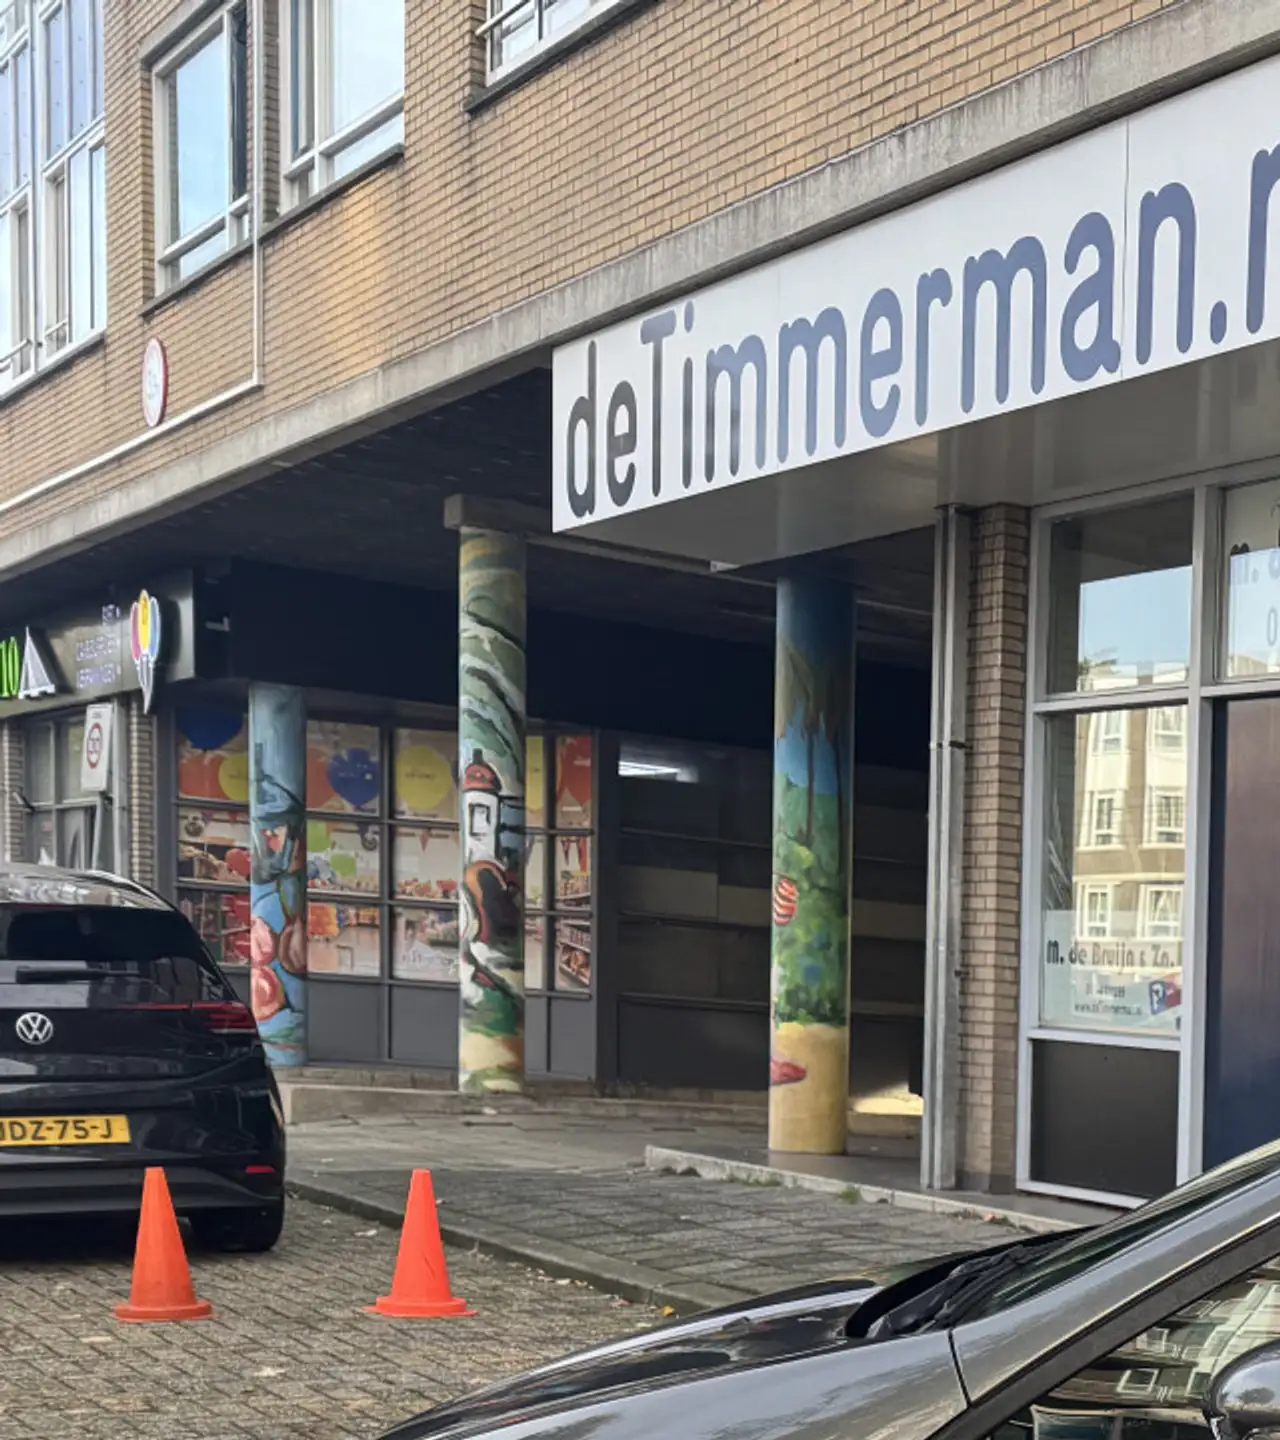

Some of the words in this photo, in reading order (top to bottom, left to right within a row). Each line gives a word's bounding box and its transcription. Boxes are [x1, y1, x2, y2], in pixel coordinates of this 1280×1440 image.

[1047, 940, 1064, 965] m.
[1068, 940, 1087, 964] de
[1092, 941, 1134, 976] Bruijn
